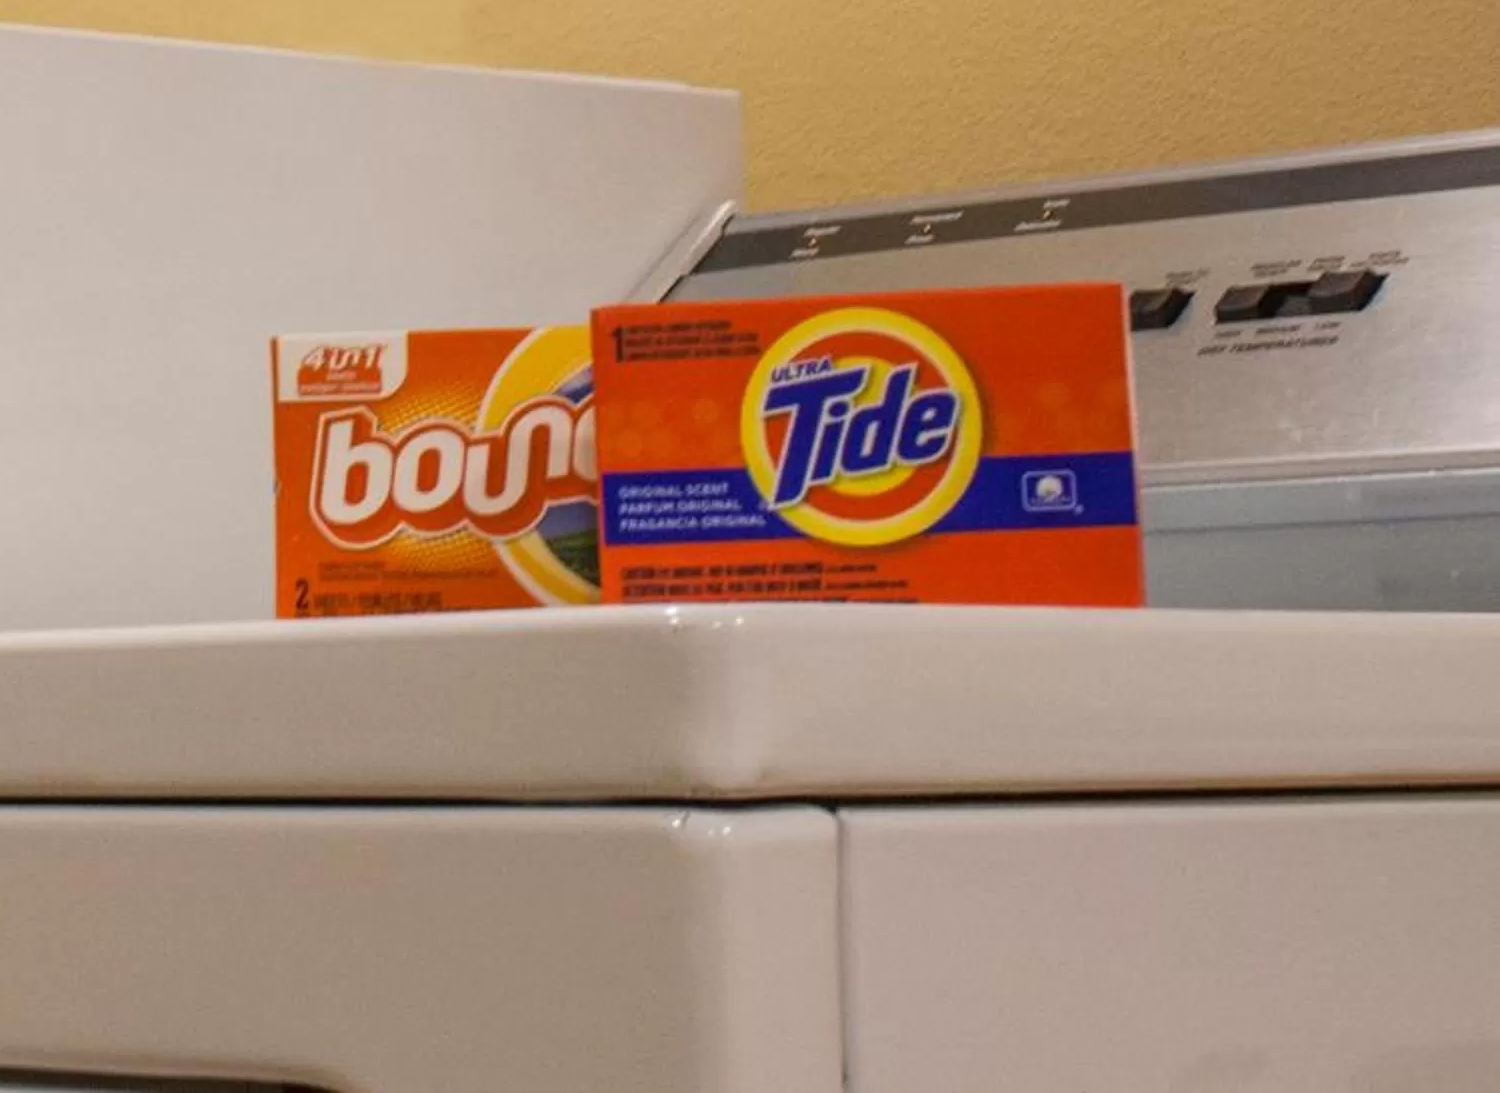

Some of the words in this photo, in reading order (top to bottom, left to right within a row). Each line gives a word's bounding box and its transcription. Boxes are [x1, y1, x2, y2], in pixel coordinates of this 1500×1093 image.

[771, 358, 832, 383] ULTRA
[763, 362, 961, 511] Tide
[618, 485, 683, 499] ORIGINAL
[685, 482, 729, 496] SCENT
[618, 501, 675, 515] PARFUM
[677, 498, 742, 512] ORIGINAL
[619, 517, 699, 532] FRAGANCIA
[701, 514, 767, 529] ORIGINAL
[295, 579, 310, 609] 2
